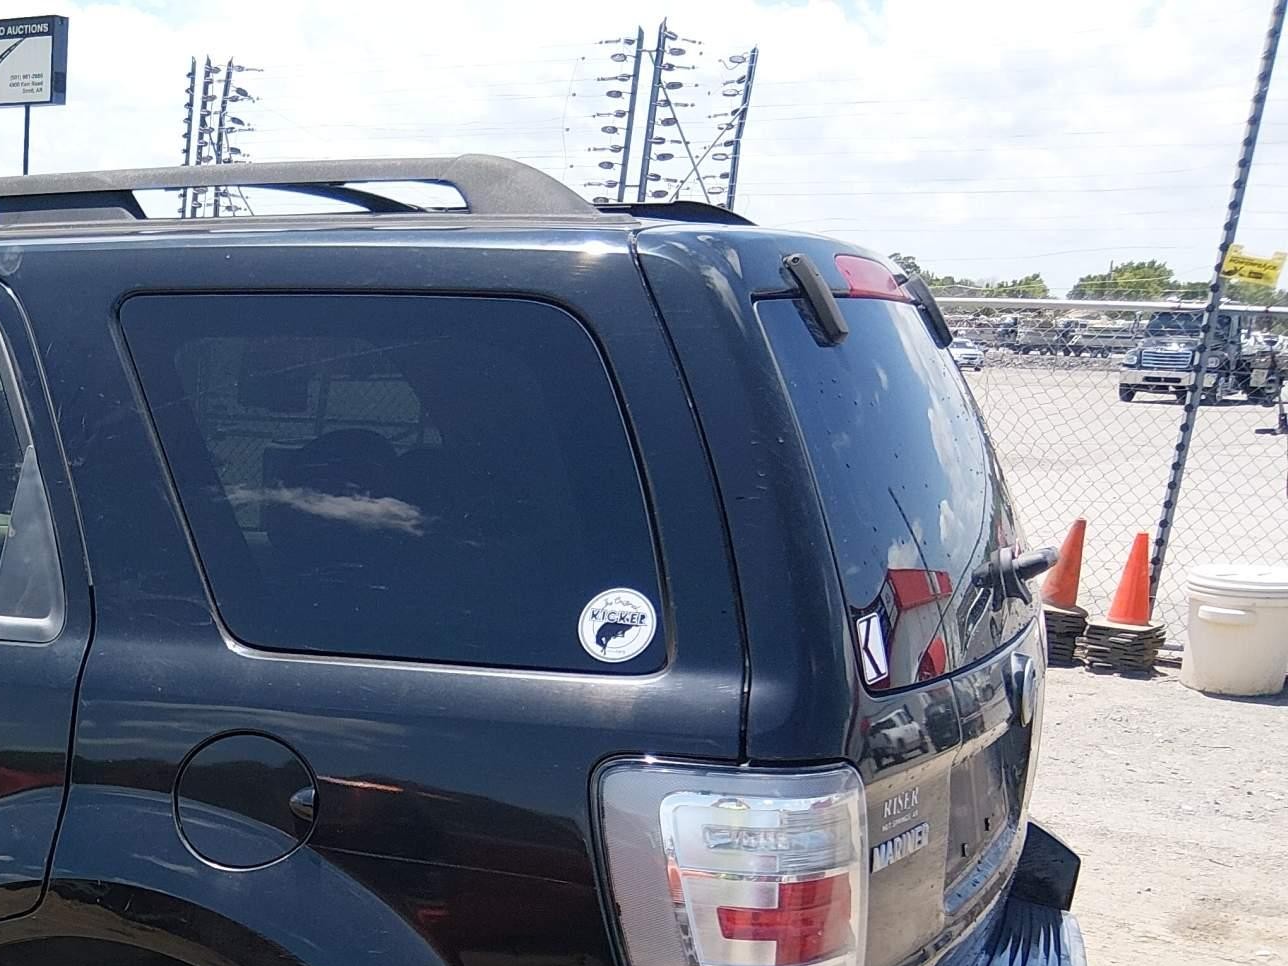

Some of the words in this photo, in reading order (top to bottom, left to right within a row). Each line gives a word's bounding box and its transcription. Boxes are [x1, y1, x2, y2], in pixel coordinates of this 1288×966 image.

[7, 23, 49, 36] AUCTIONS
[590, 608, 647, 625] KICKER
[872, 822, 930, 873] MARINER
